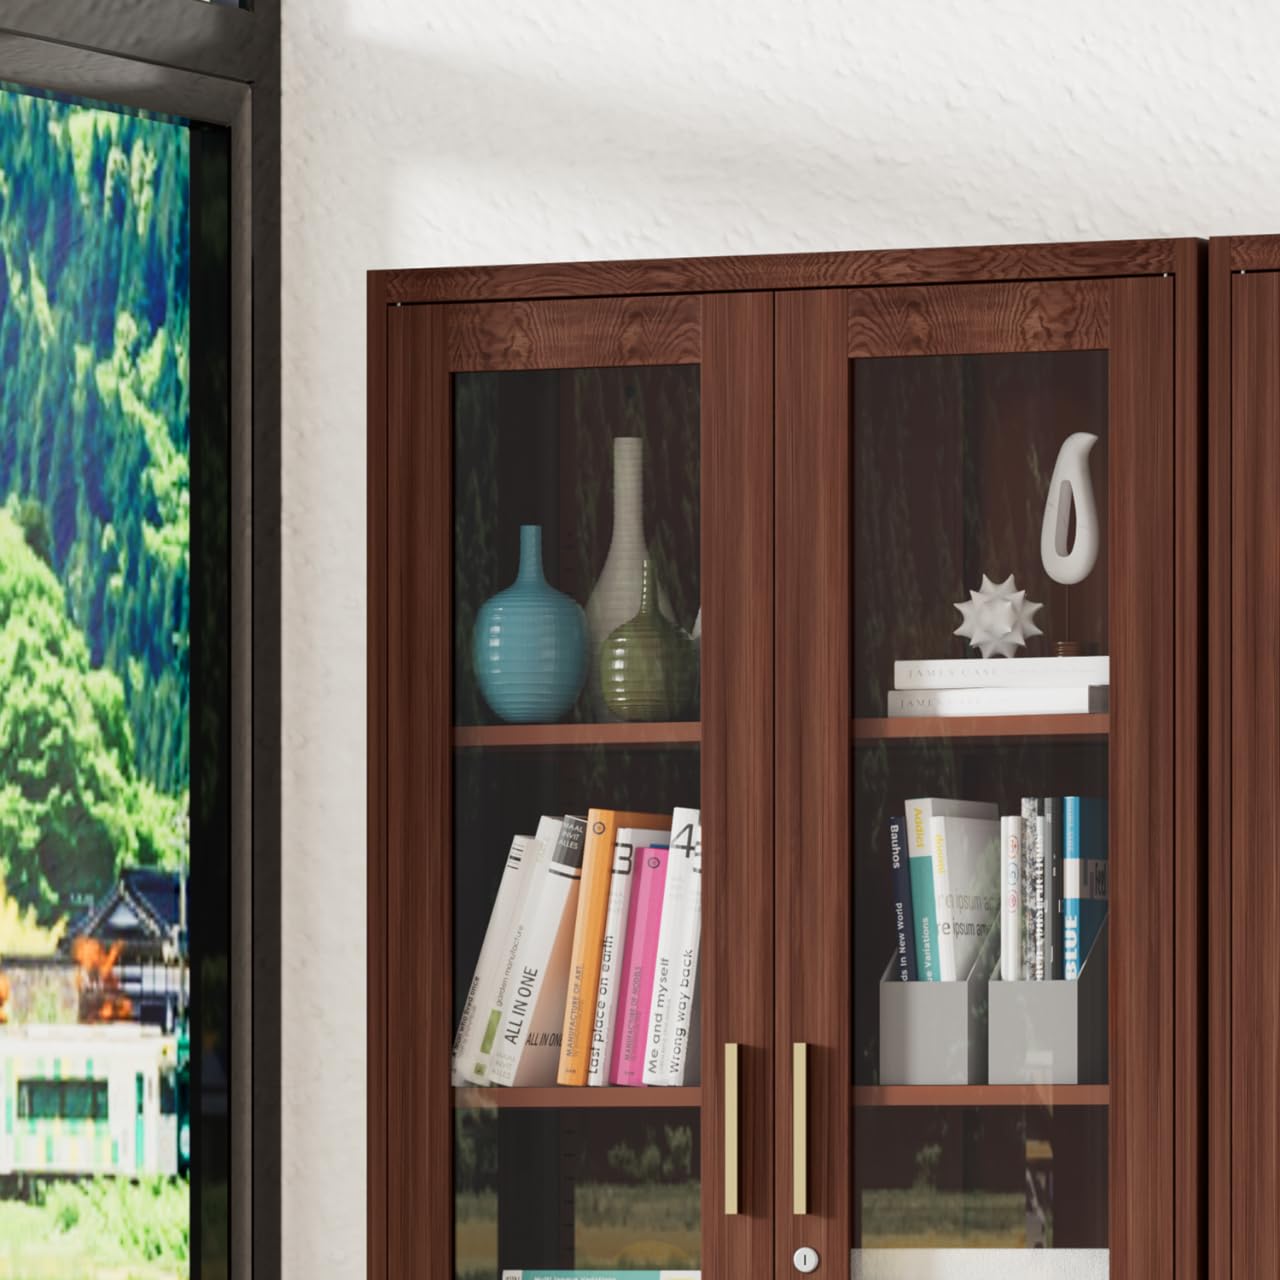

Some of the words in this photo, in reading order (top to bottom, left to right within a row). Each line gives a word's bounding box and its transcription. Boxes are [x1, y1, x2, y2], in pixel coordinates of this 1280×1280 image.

[671, 823, 695, 858] 4
[897, 932, 906, 954] New
[1065, 915, 1078, 981] BLUE
[518, 966, 538, 999] ONE
[657, 958, 669, 1008] myself
[680, 949, 693, 988] back
[512, 1001, 529, 1017] IN
[592, 1003, 606, 1043] place
[599, 978, 608, 997] on
[677, 993, 691, 1023] way
[505, 1017, 523, 1046] ALL
[653, 1013, 664, 1044] and
[648, 1049, 659, 1074] Me
[669, 1027, 687, 1074] Wrong
